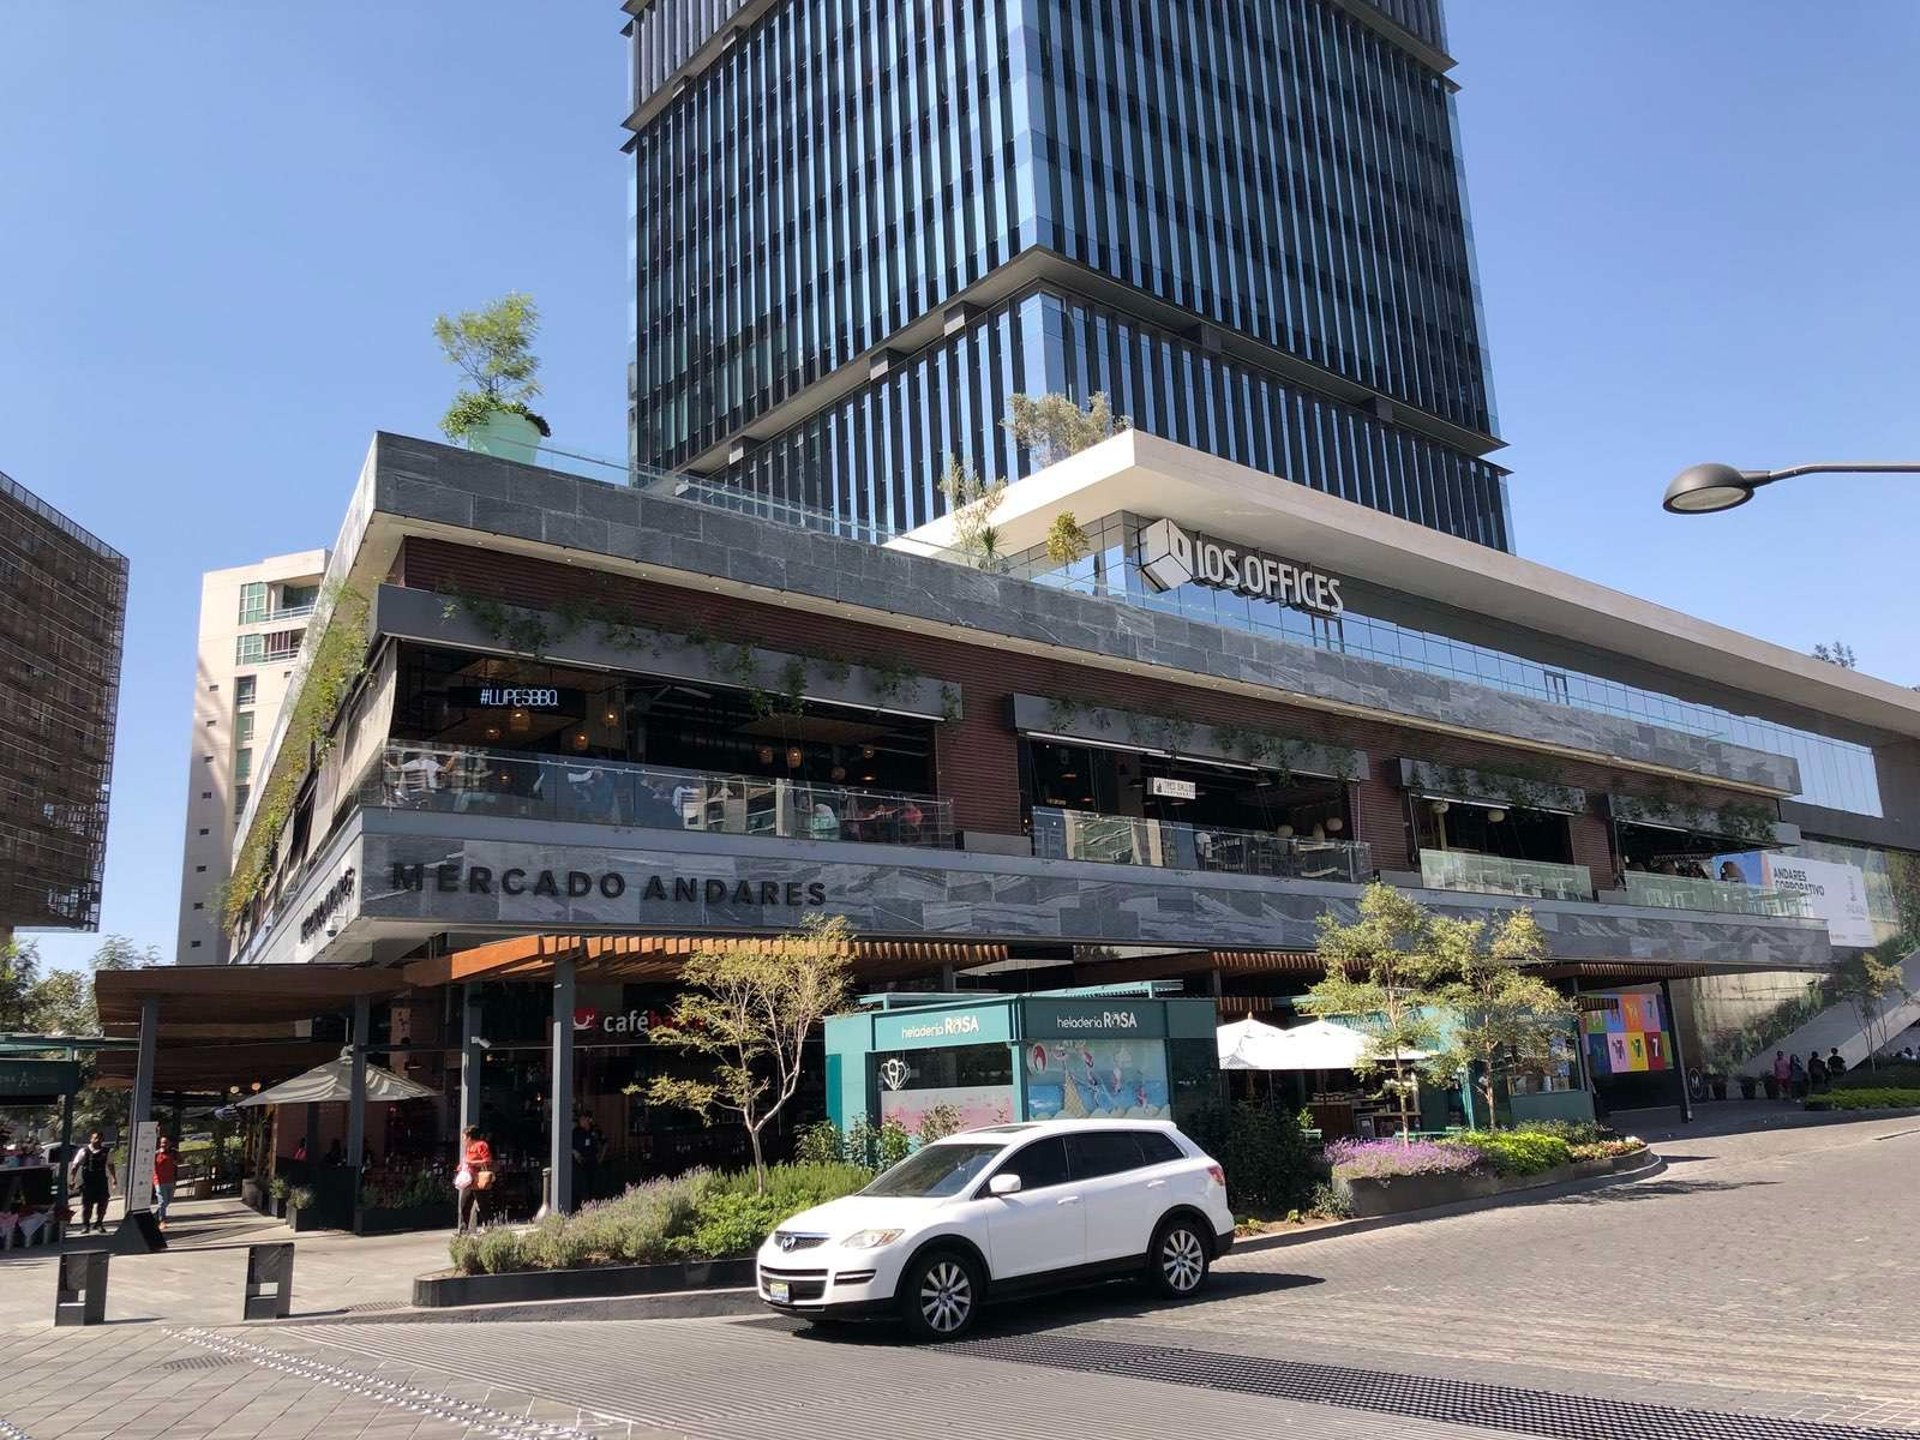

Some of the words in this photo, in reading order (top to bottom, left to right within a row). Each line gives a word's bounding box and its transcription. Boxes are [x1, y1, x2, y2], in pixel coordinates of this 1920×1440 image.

[1244, 556, 1344, 614] OFFICES
[391, 862, 626, 898] MERCADO
[643, 875, 827, 906] ANDARES
[1774, 867, 1807, 882] ANDARES
